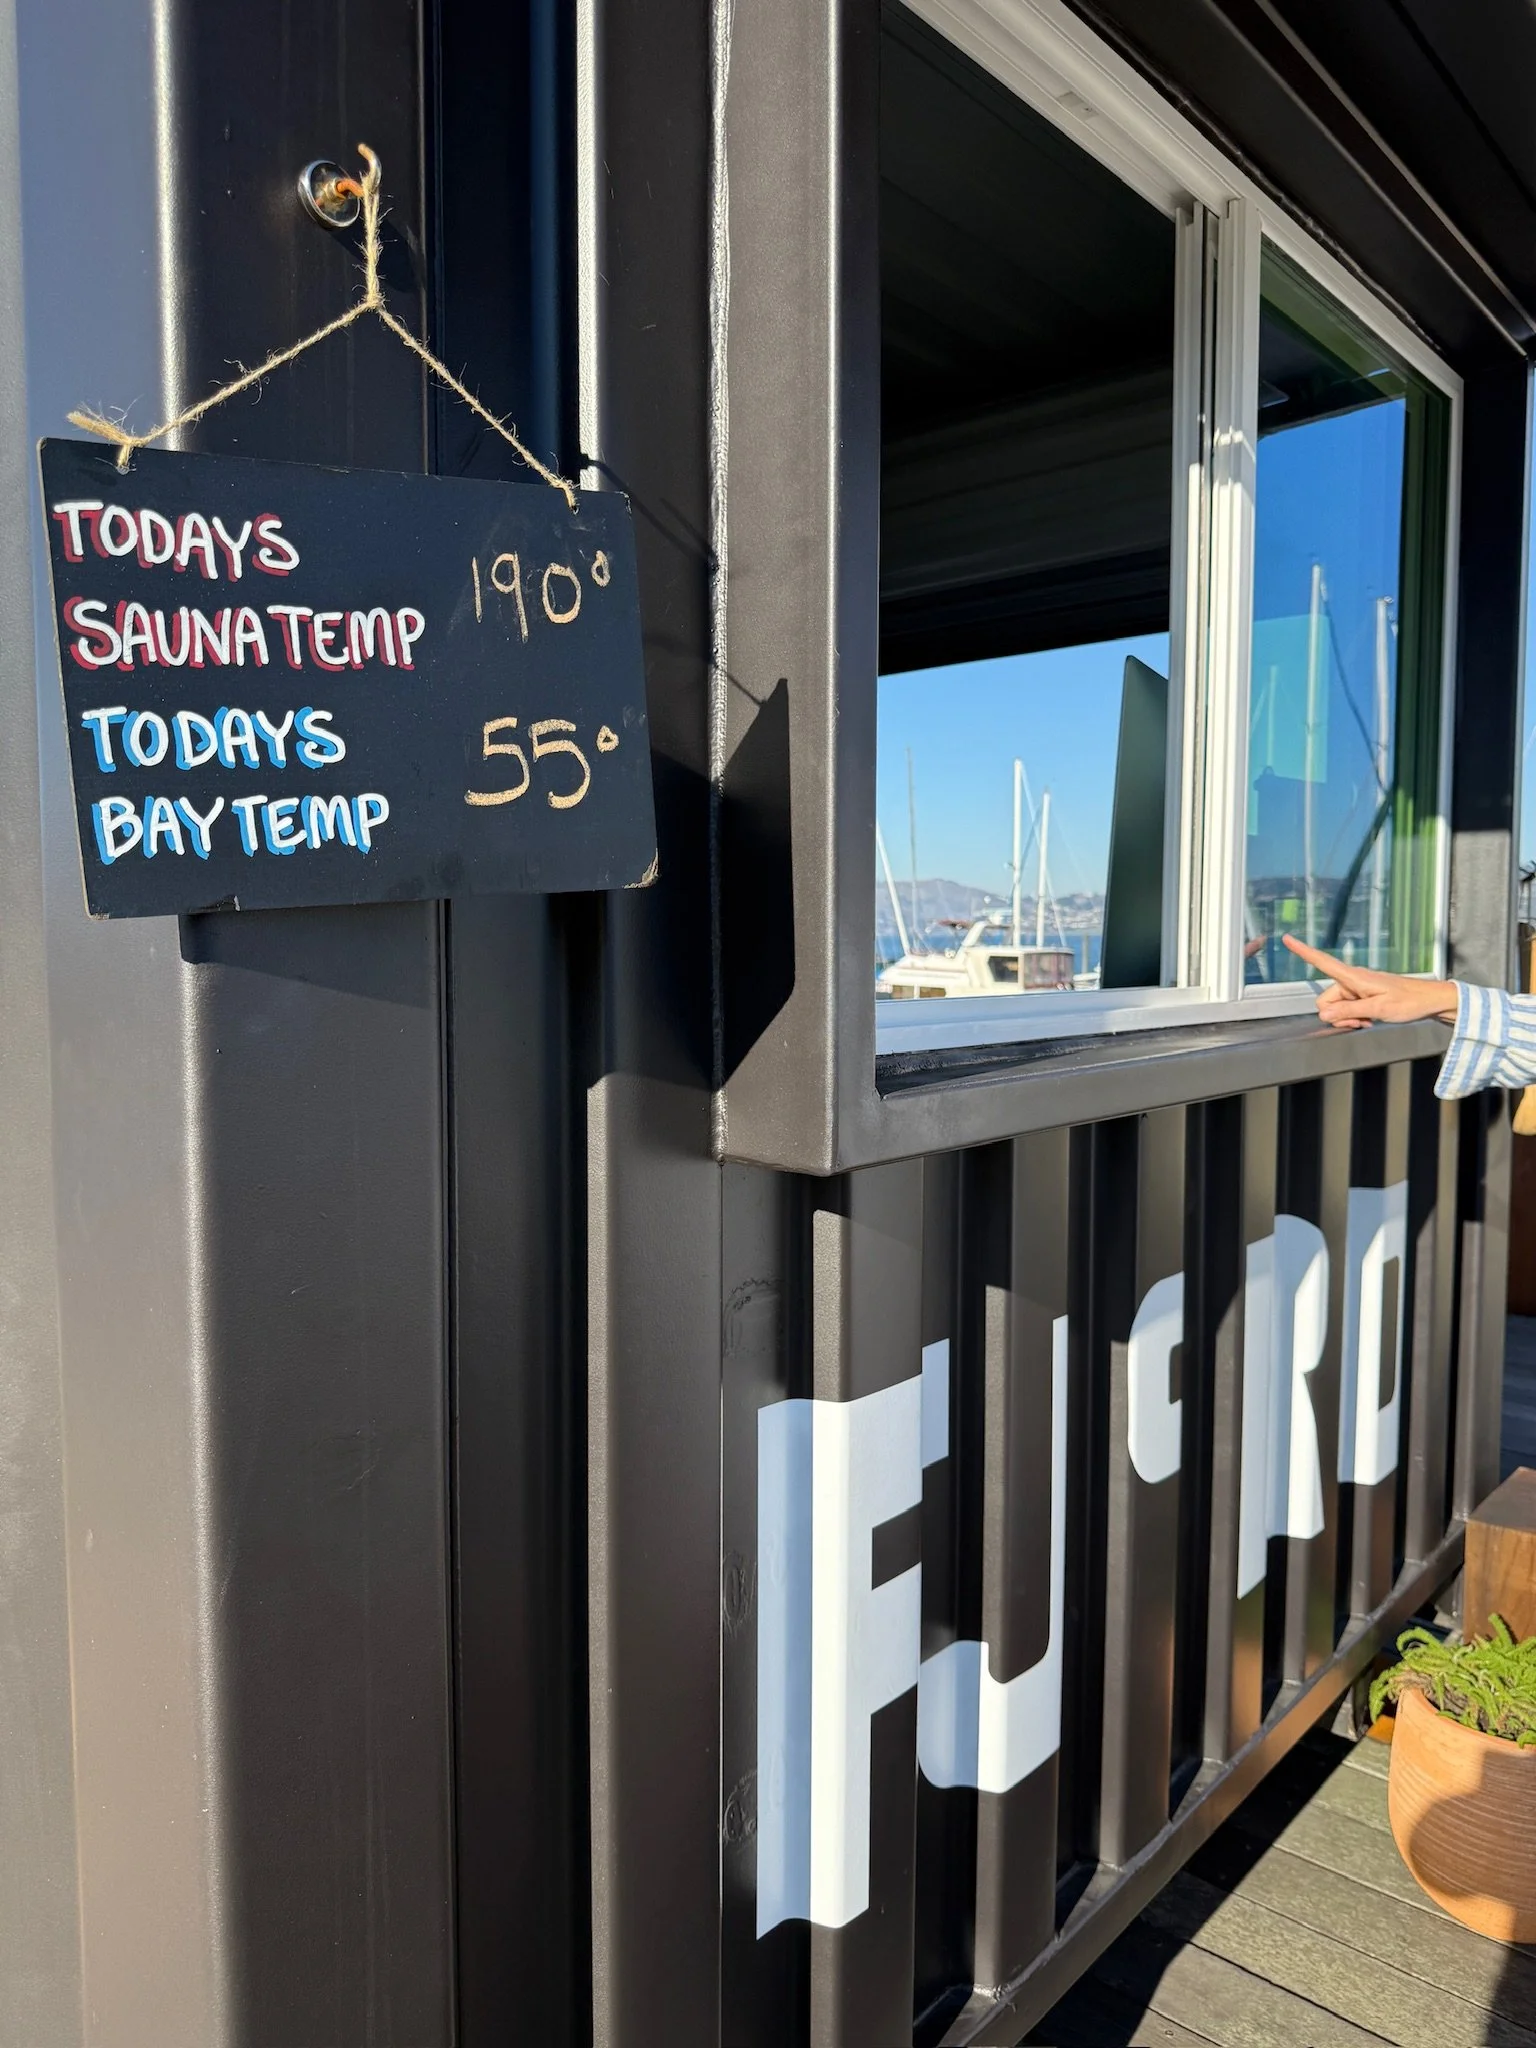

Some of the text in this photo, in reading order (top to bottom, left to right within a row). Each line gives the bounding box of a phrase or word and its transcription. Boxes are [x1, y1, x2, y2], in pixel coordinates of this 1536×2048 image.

[53, 501, 300, 582] TODAYS
[64, 596, 425, 672] SAUNA TEMP
[82, 706, 346, 772] TODAYS
[91, 793, 390, 865] BAY TEMP
